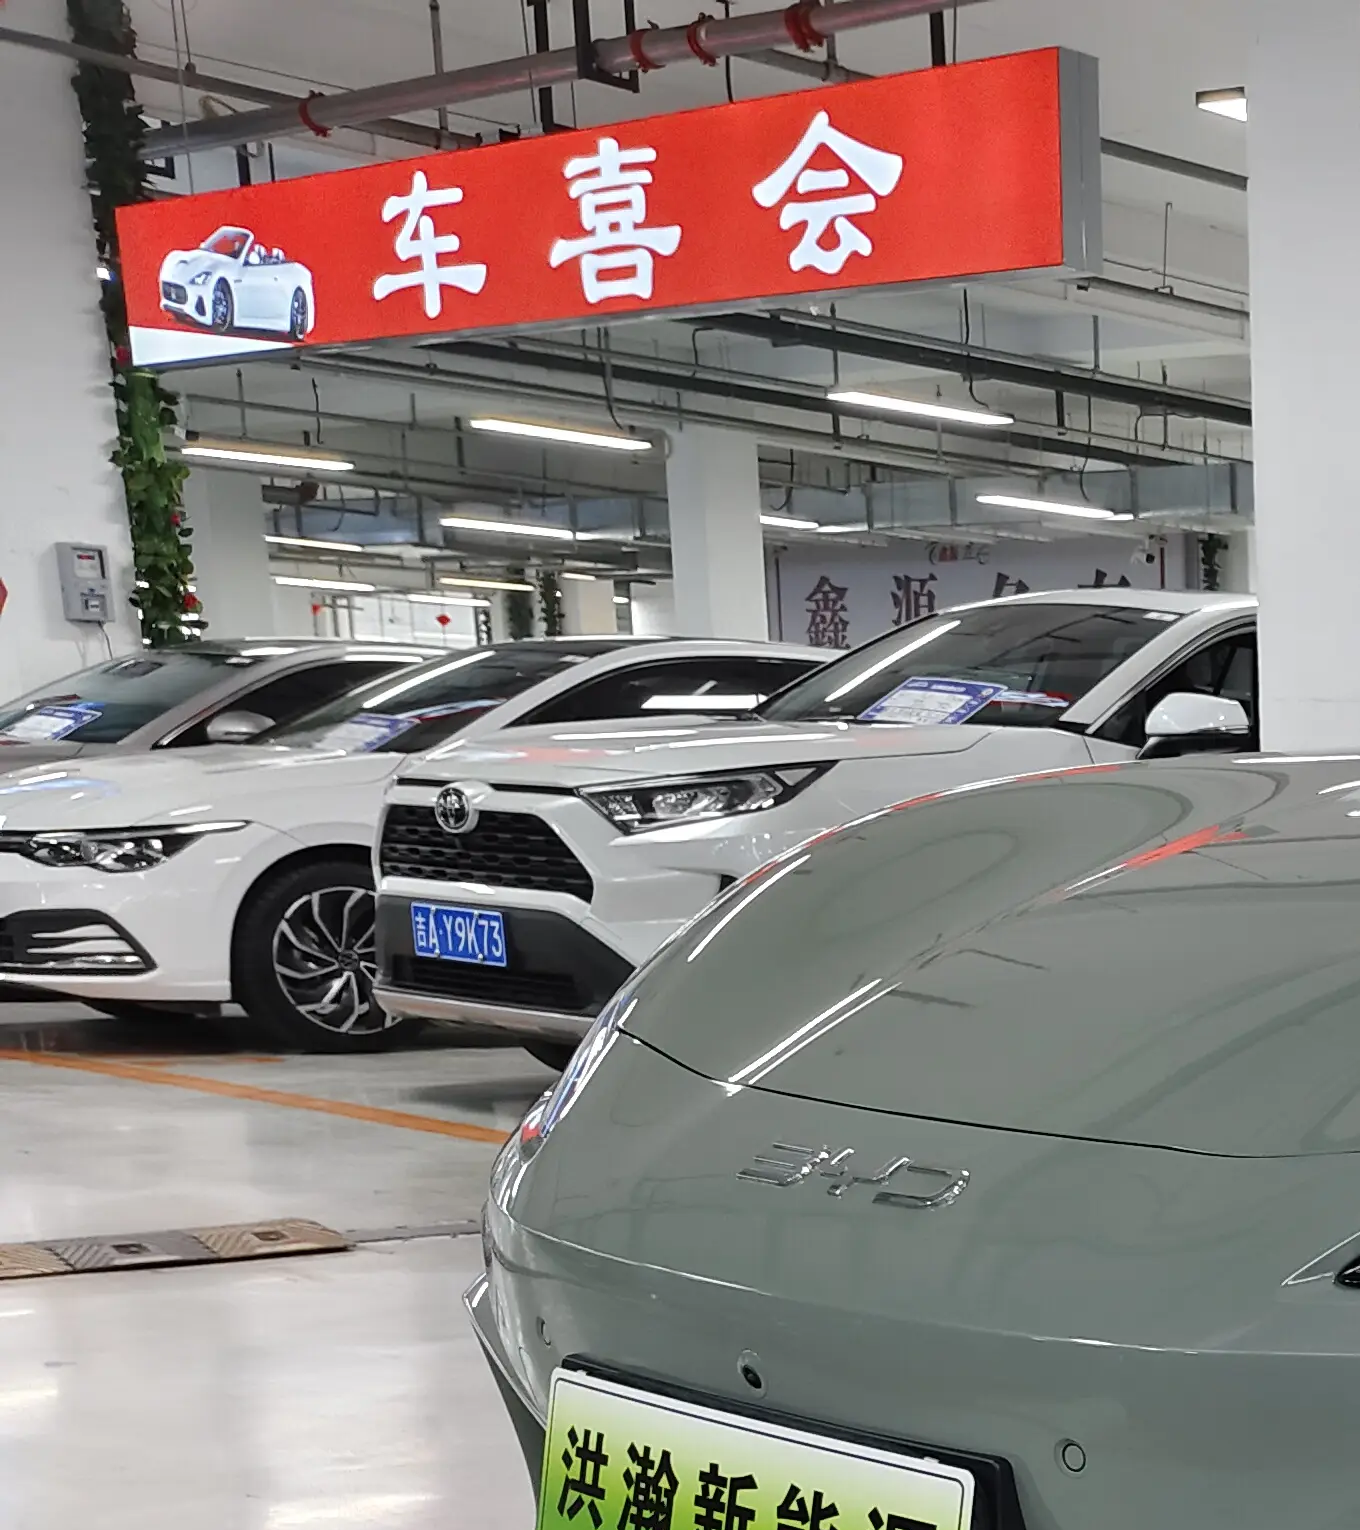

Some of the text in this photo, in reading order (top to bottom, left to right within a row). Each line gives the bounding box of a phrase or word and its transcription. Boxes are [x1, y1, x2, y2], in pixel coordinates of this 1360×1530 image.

[373, 110, 903, 319] 车喜会
[805, 568, 1132, 650] 鑫源
[735, 1143, 971, 1210] BYD
